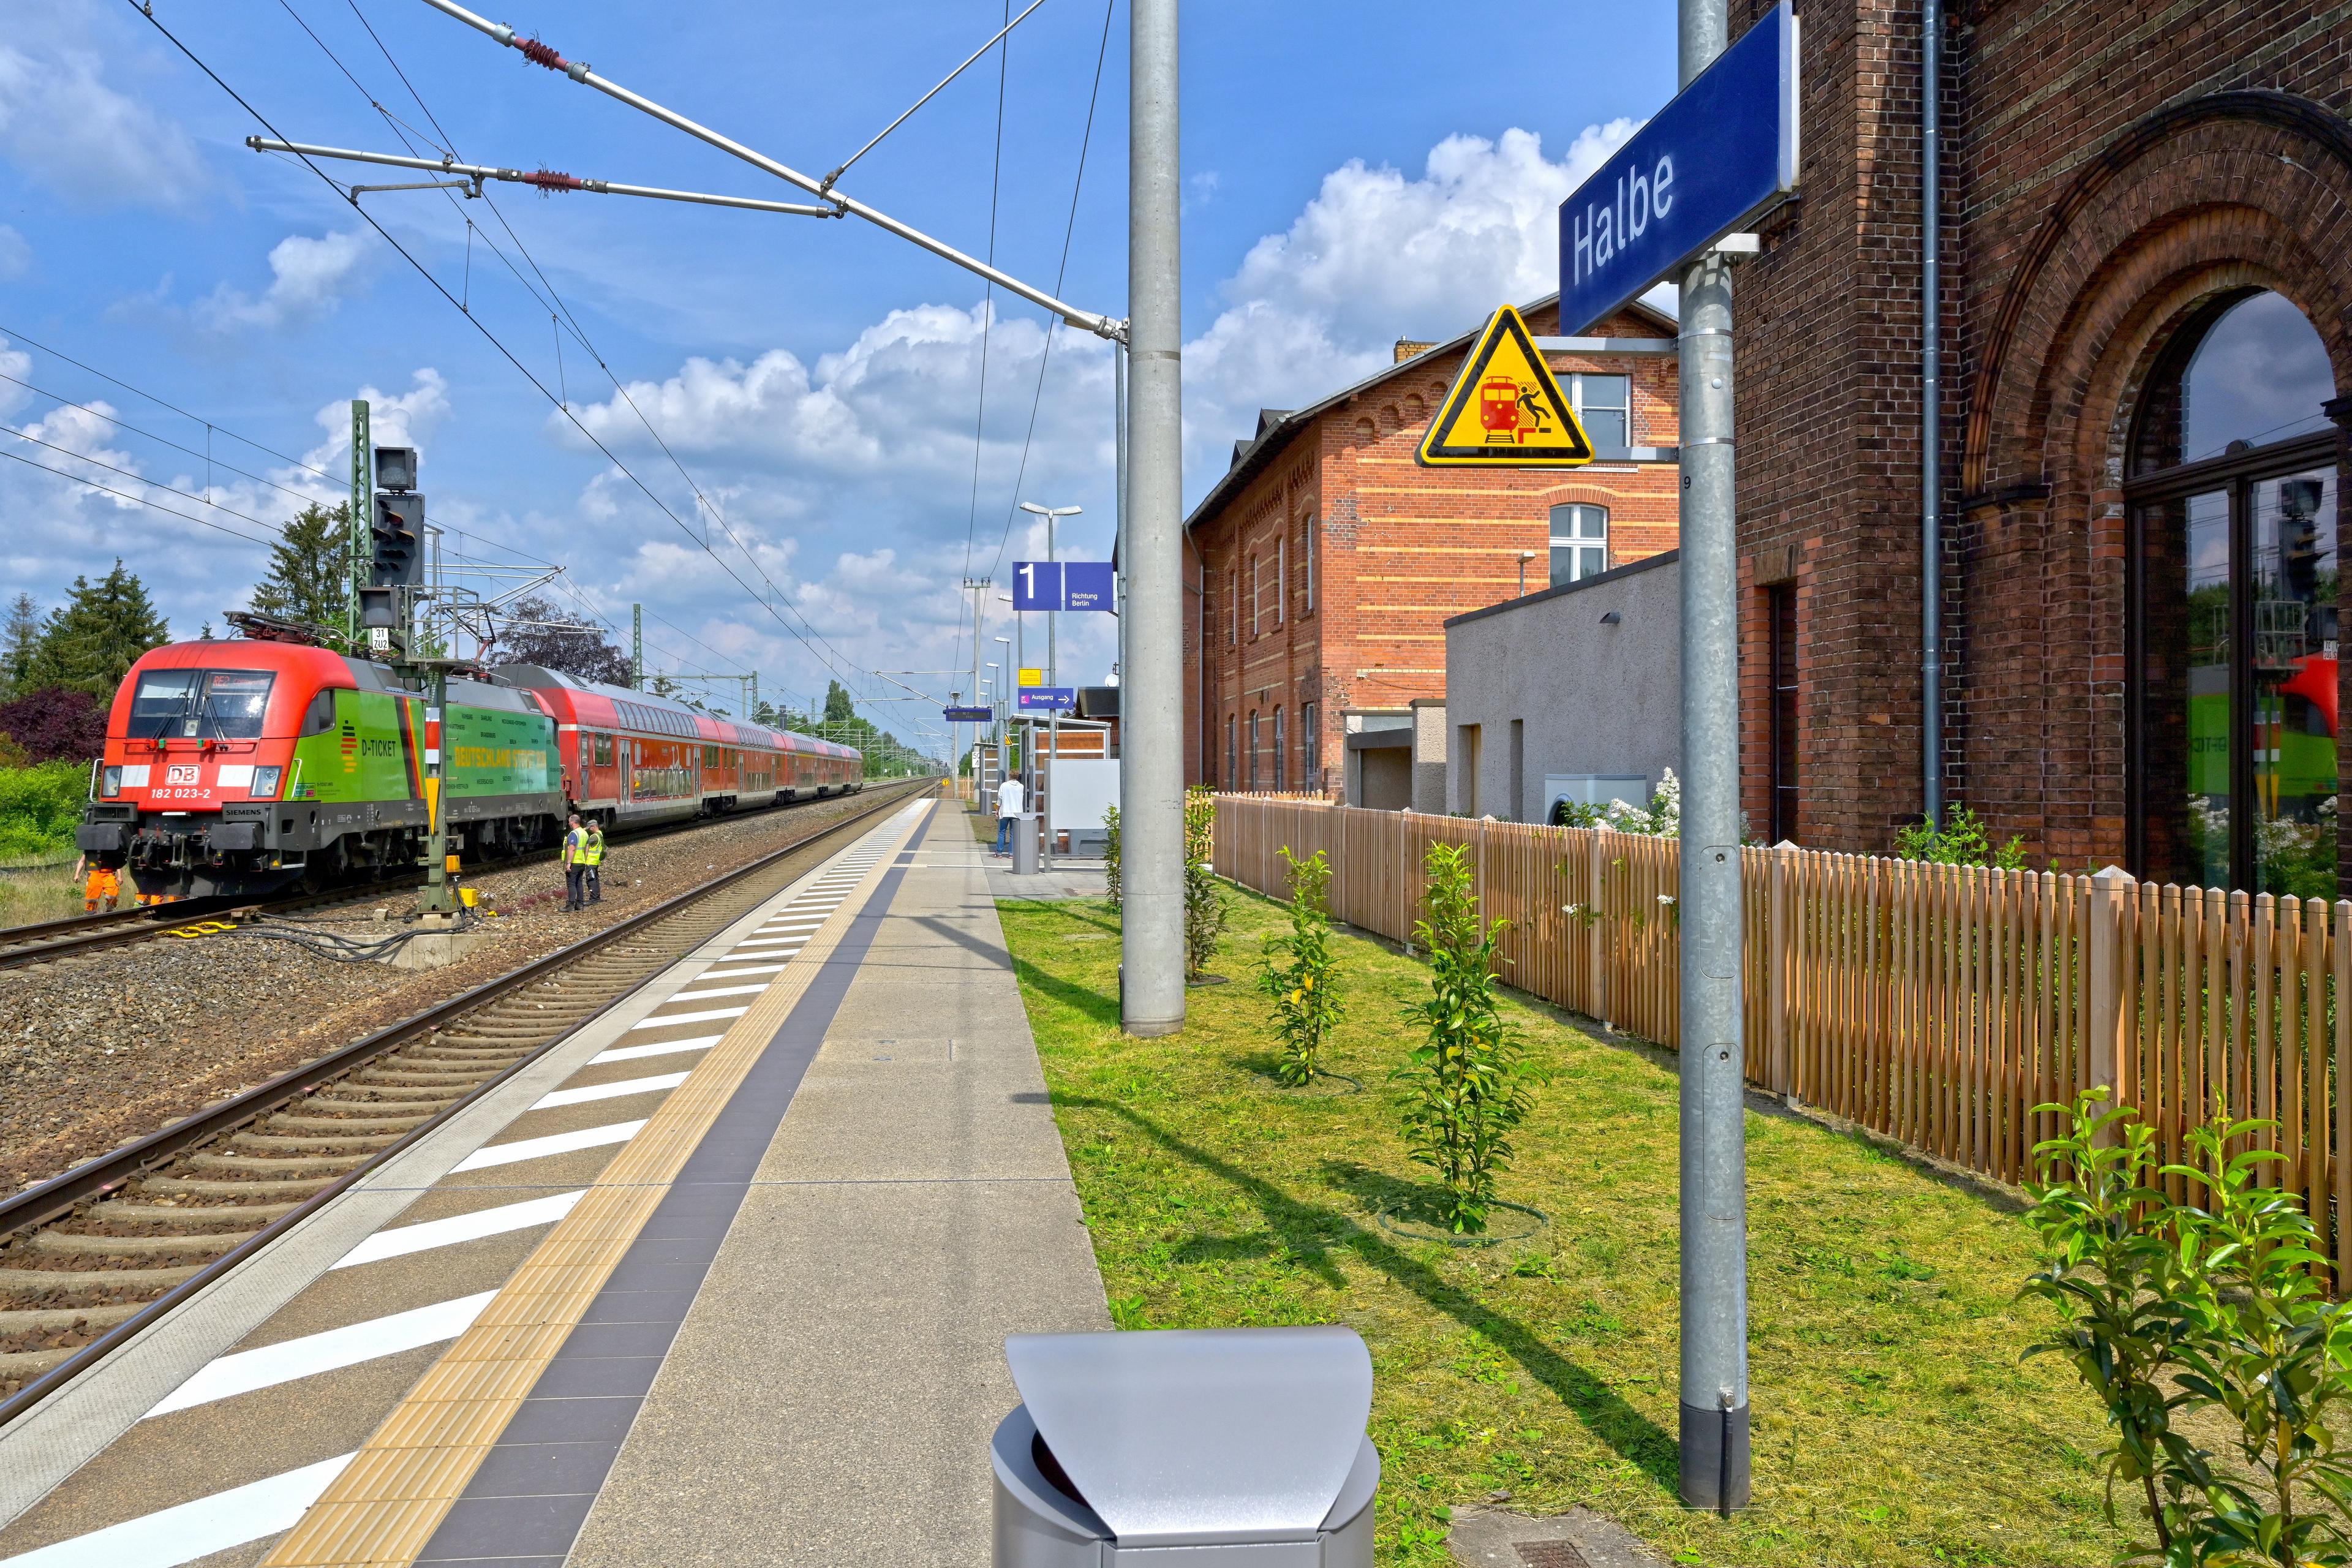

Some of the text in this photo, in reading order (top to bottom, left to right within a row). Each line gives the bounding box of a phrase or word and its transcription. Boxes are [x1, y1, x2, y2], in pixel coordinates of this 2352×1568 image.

[1574, 155, 1673, 287] Halbe
[1684, 476, 1691, 489] 9
[1019, 563, 1034, 599] 1
[376, 629, 384, 638] 31
[213, 676, 230, 687] RE2
[362, 739, 396, 757] D-TICKET
[170, 767, 196, 782] DB
[151, 788, 211, 799] 182 023-2
